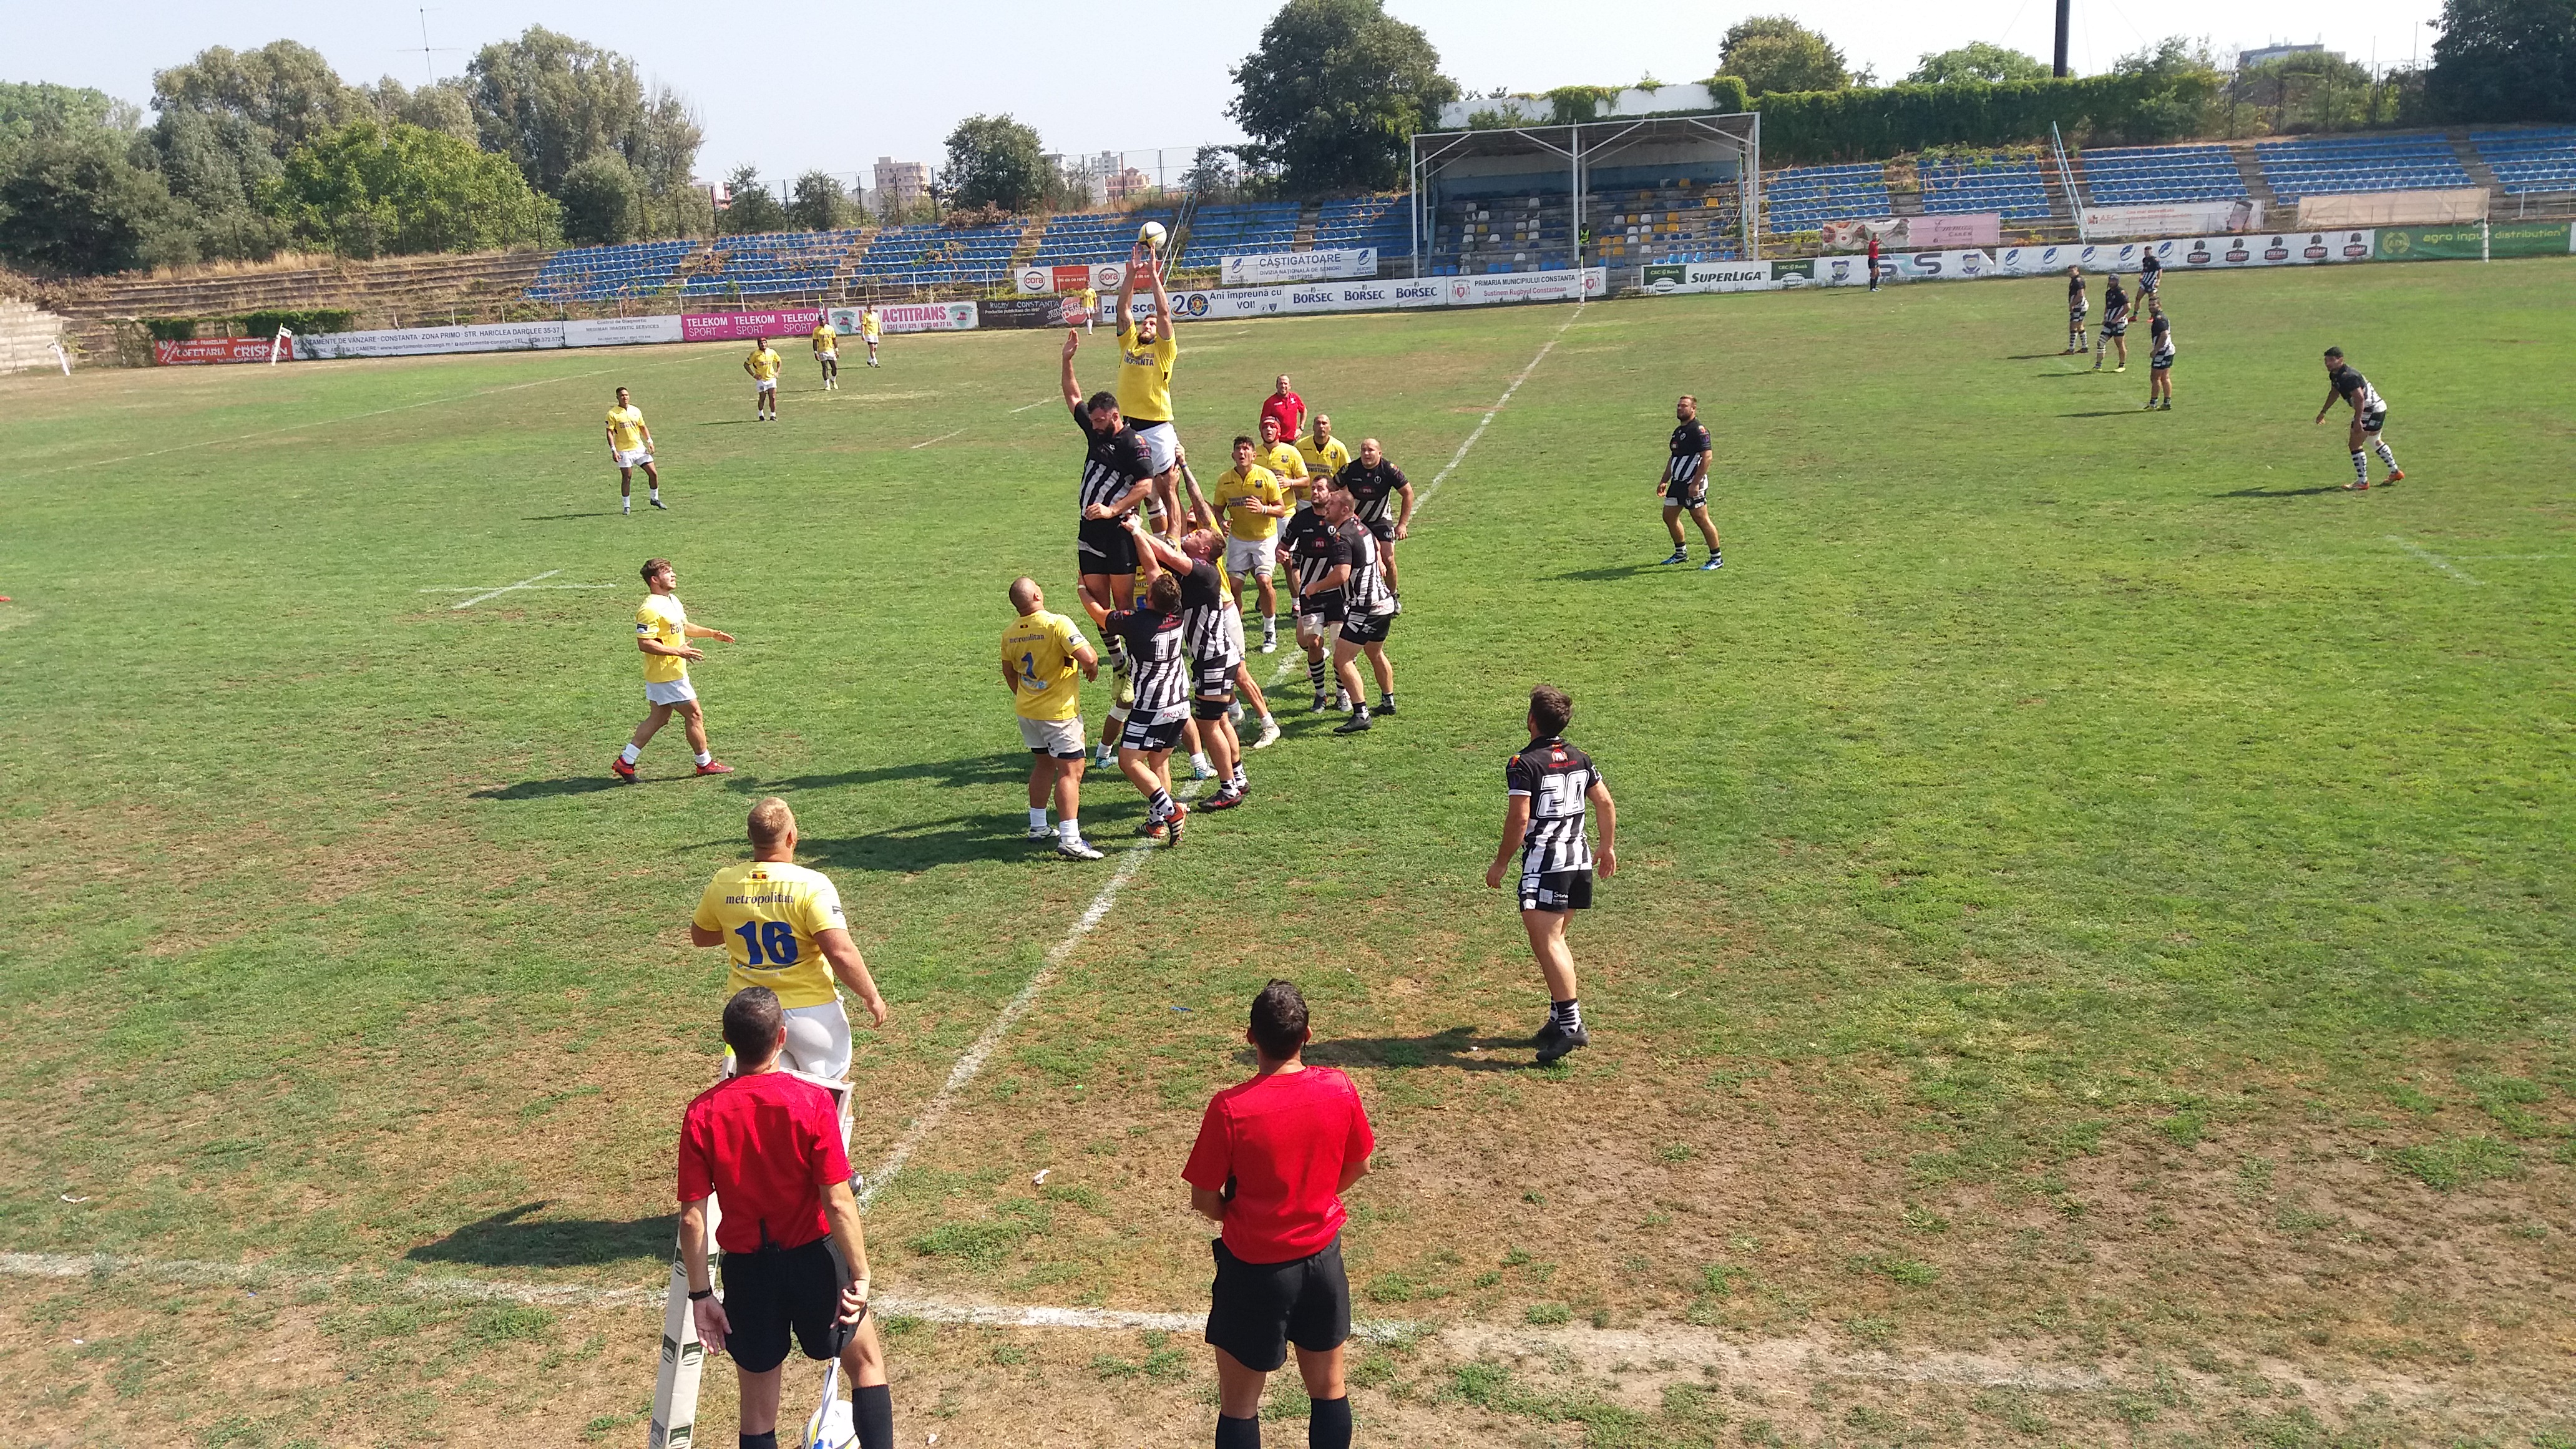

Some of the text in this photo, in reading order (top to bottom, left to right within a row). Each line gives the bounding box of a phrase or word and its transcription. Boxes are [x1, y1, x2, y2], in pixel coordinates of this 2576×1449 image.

[2423, 228, 2560, 243] agro inpu distribution
[1503, 276, 1540, 285] MUNICIPIULUI
[1691, 271, 1762, 283] SUPERLIGA
[1209, 291, 1224, 300] Ani
[1227, 288, 1269, 301] împreună
[1344, 290, 1385, 301] BORSEC
[1395, 286, 1438, 298] BORSEC
[1510, 287, 1531, 296] Rugbyul
[1533, 286, 1567, 294] Constantean
[1293, 292, 1334, 304] BORSEC
[990, 300, 1060, 310] RUGBY CONSTANTA
[1237, 301, 1256, 310] VOI!
[882, 306, 947, 323] ACTITRANS
[686, 316, 728, 327] TELEKOM
[734, 315, 775, 326] TELEKOM
[689, 323, 812, 337] SPORT SPORT SPORT
[381, 333, 418, 342] CONSTANTA
[1150, 620, 1184, 661] 17
[1021, 651, 1038, 680] 1
[1536, 769, 1590, 819] 20
[726, 892, 794, 907] metropolitan
[734, 920, 799, 965] 16
